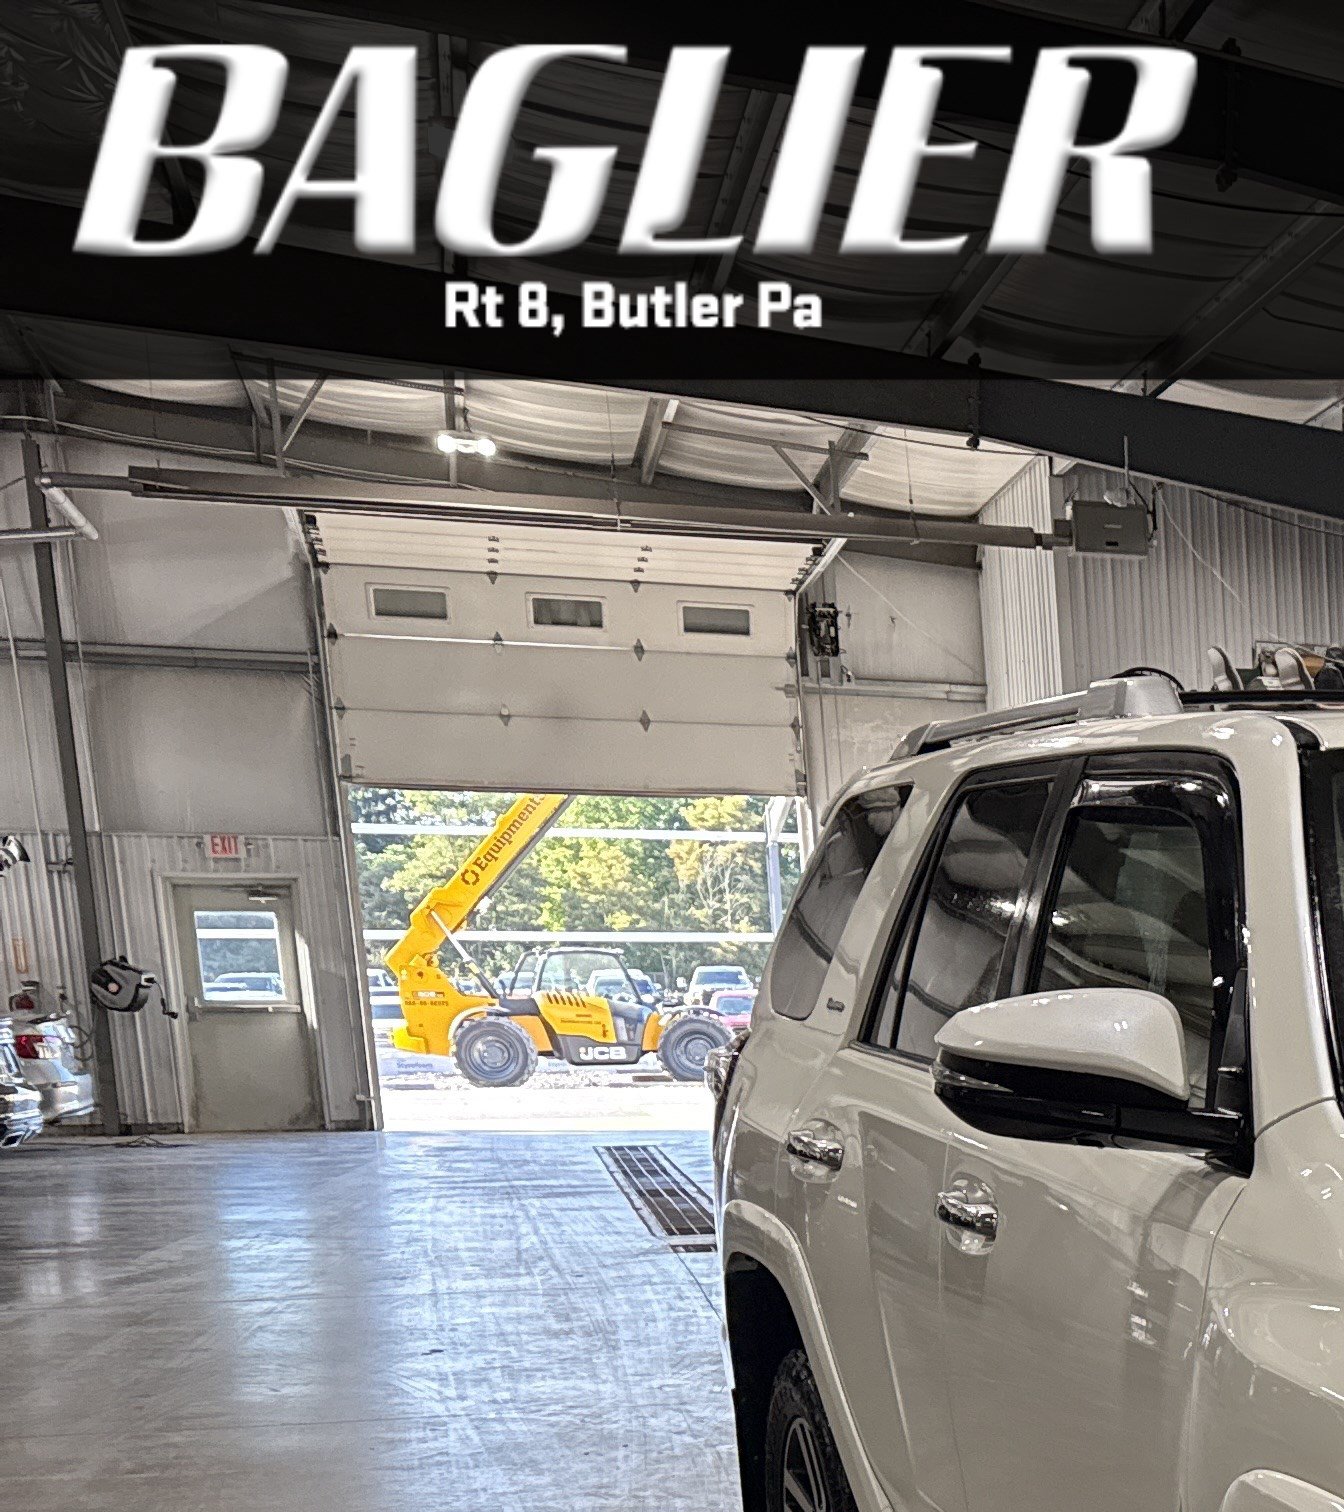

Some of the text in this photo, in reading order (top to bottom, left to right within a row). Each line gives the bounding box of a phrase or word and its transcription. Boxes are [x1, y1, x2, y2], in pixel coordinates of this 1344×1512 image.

[210, 833, 239, 855] EXIT
[472, 796, 546, 872] Equipment
[579, 1046, 627, 1061] JCB
